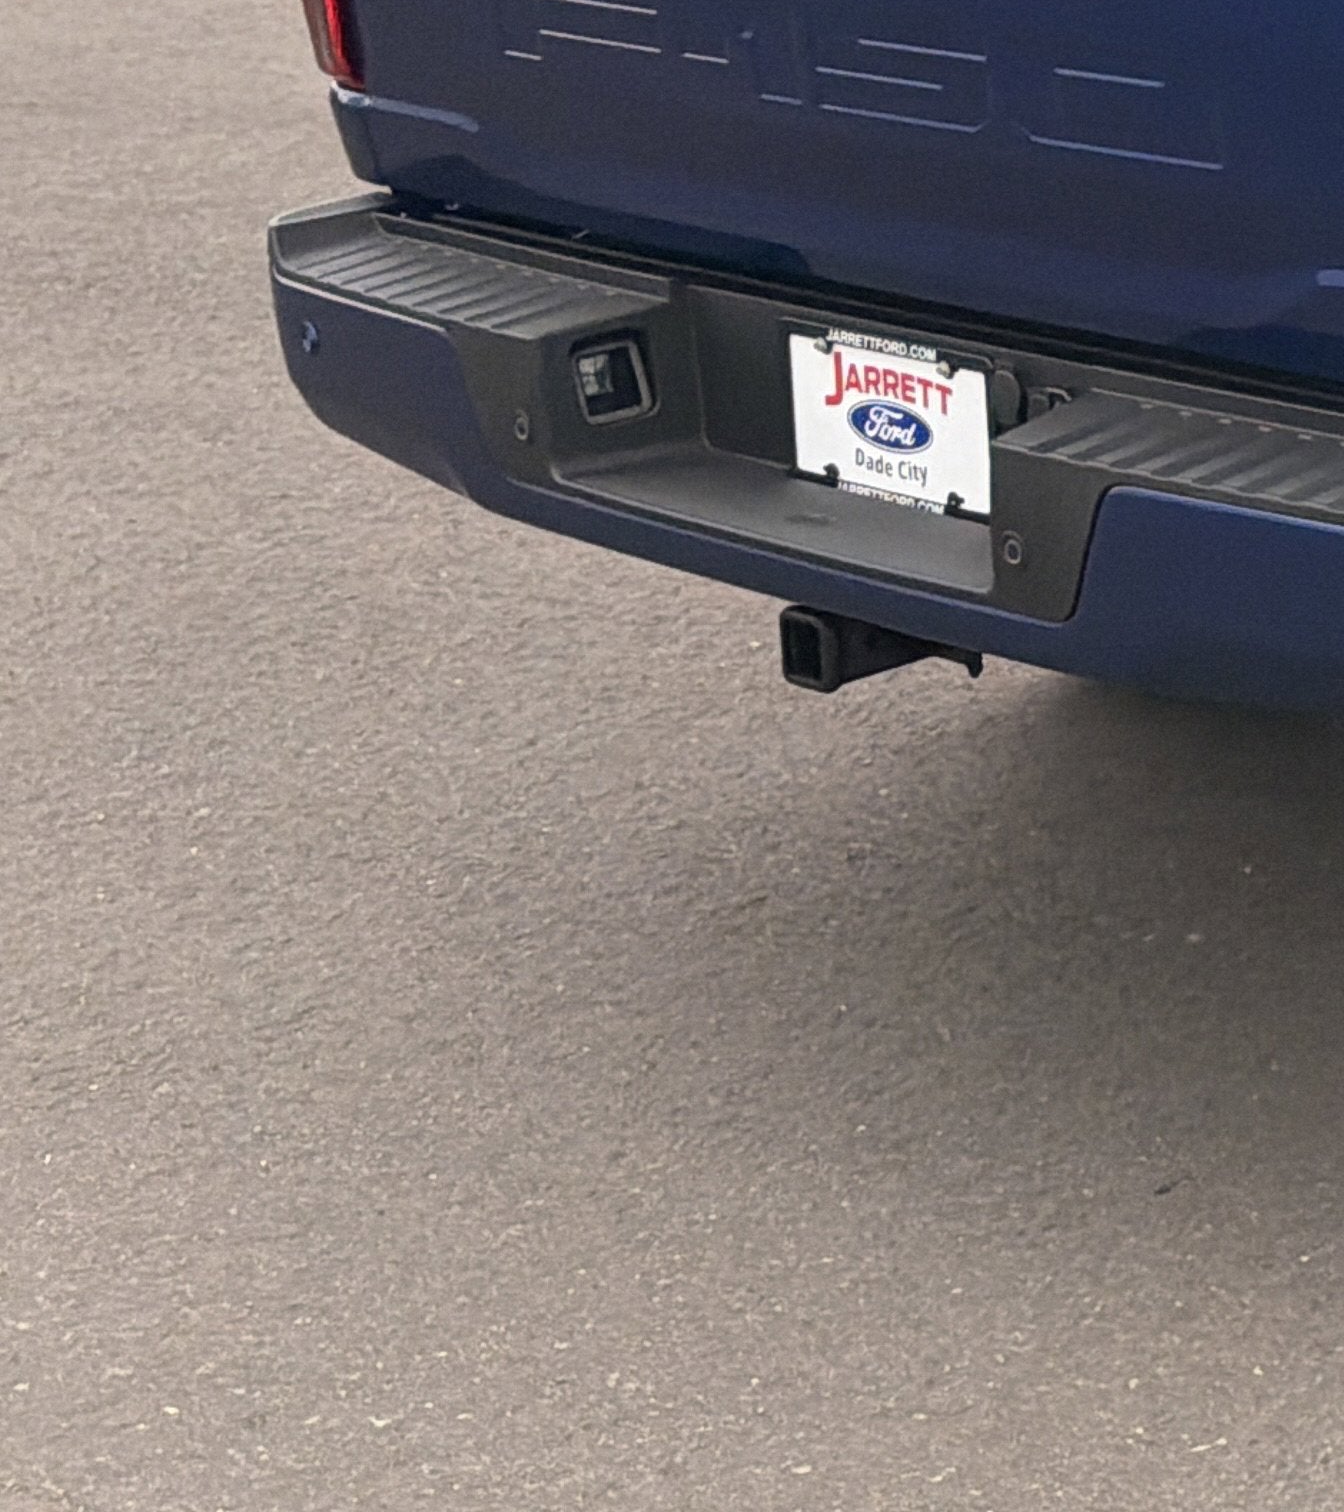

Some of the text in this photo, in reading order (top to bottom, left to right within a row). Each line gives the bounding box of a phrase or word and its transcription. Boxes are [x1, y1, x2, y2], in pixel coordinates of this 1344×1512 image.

[826, 328, 937, 361] JARRETTFORD.COM
[825, 351, 953, 415] JARRETT
[864, 406, 917, 447] Ford
[855, 448, 928, 488] Dade City
